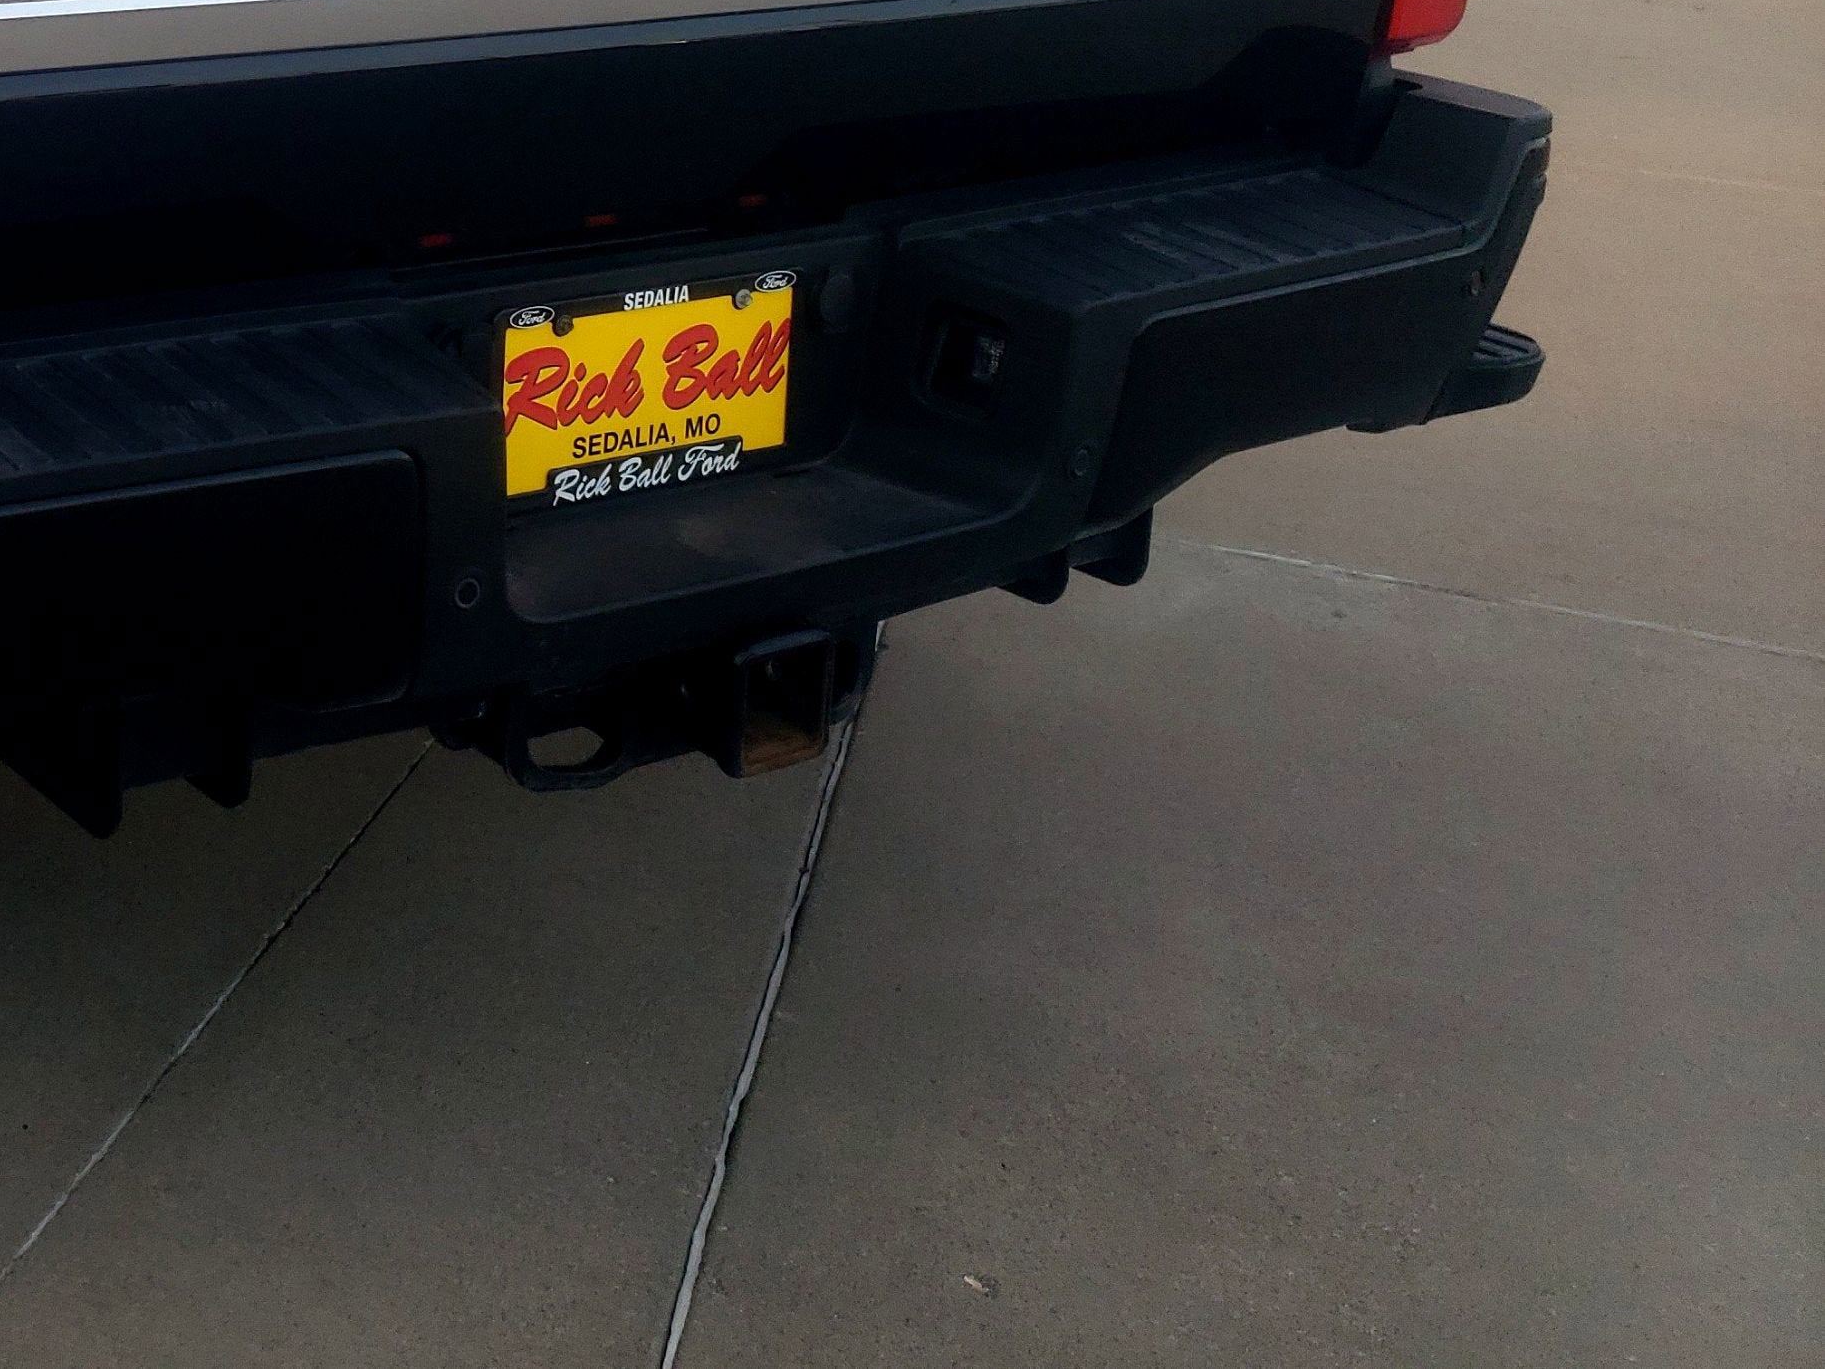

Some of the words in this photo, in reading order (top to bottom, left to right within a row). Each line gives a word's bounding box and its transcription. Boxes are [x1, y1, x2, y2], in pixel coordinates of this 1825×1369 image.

[623, 285, 689, 311] SEDALIA
[504, 338, 646, 436] Rick
[661, 318, 791, 410] Ball
[572, 427, 677, 459] SEDALIA,
[684, 413, 721, 439] MO
[553, 465, 612, 507] Rick
[619, 453, 671, 491] Ball
[677, 441, 742, 482] Ford
